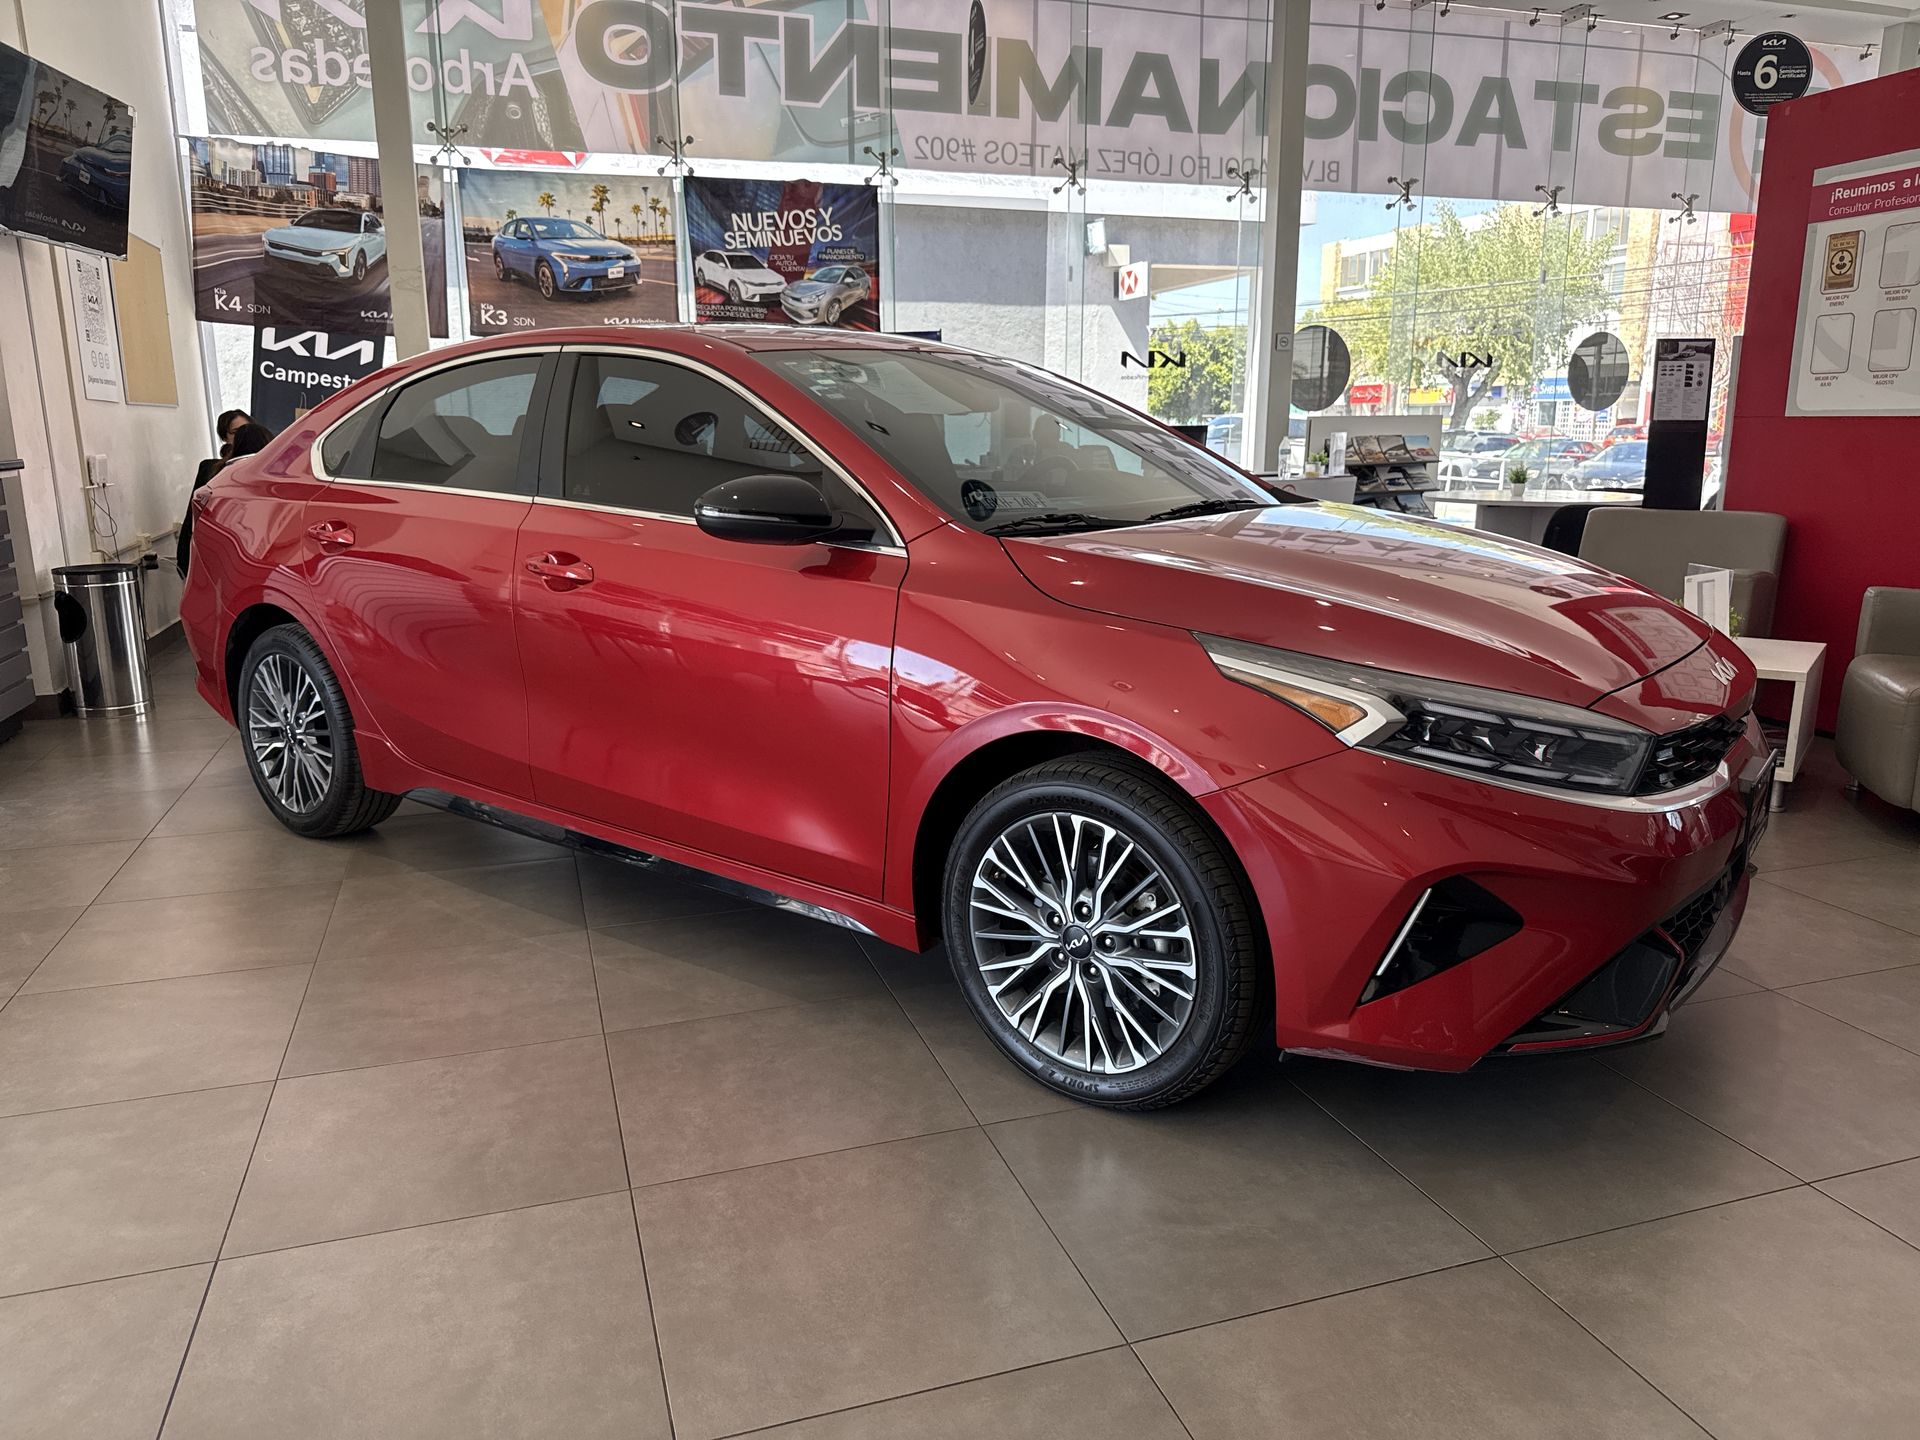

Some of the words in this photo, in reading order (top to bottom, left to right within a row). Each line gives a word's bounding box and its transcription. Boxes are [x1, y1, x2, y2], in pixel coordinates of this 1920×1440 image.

[1762, 38, 1787, 46] KIA
[1754, 54, 1778, 90] 6
[1831, 181, 1896, 204] ¡Reunimos
[1902, 178, 1911, 188] a
[1828, 202, 1872, 216] Consultor
[731, 208, 818, 233] NUEVOS
[818, 206, 833, 226] Y
[724, 224, 843, 250] SEMINUEVOS
[214, 287, 226, 295] Kia
[214, 294, 242, 312] K4
[247, 303, 271, 315] SDN
[480, 303, 494, 311] Kia
[480, 310, 508, 326] K3
[513, 317, 536, 327] SDN
[261, 326, 375, 366] KIA
[1066, 934, 1089, 950] KIA
